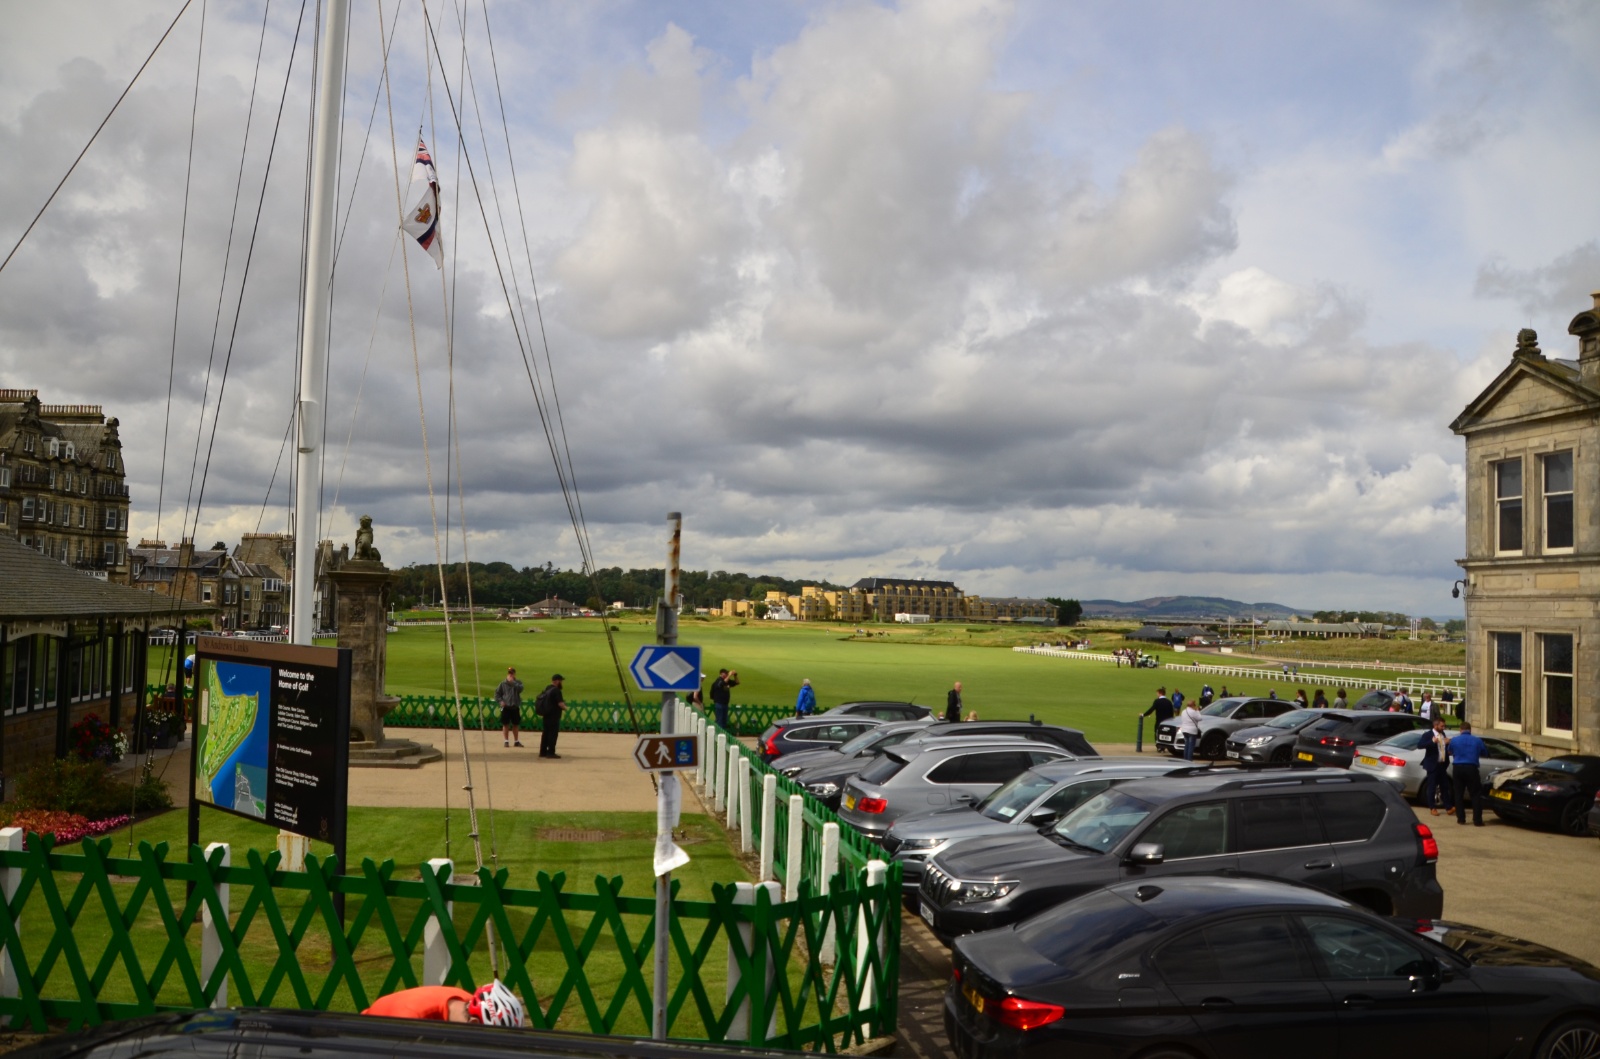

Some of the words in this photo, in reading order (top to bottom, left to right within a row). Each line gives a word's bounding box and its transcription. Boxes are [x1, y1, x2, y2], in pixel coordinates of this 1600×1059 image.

[203, 638, 209, 648] St
[210, 639, 233, 650] Andrews
[233, 641, 249, 653] Links
[278, 669, 299, 679] Welcome
[299, 672, 306, 680] to
[306, 672, 315, 681] the
[278, 680, 291, 689] Home
[292, 682, 298, 690] of
[299, 683, 309, 692] Golf
